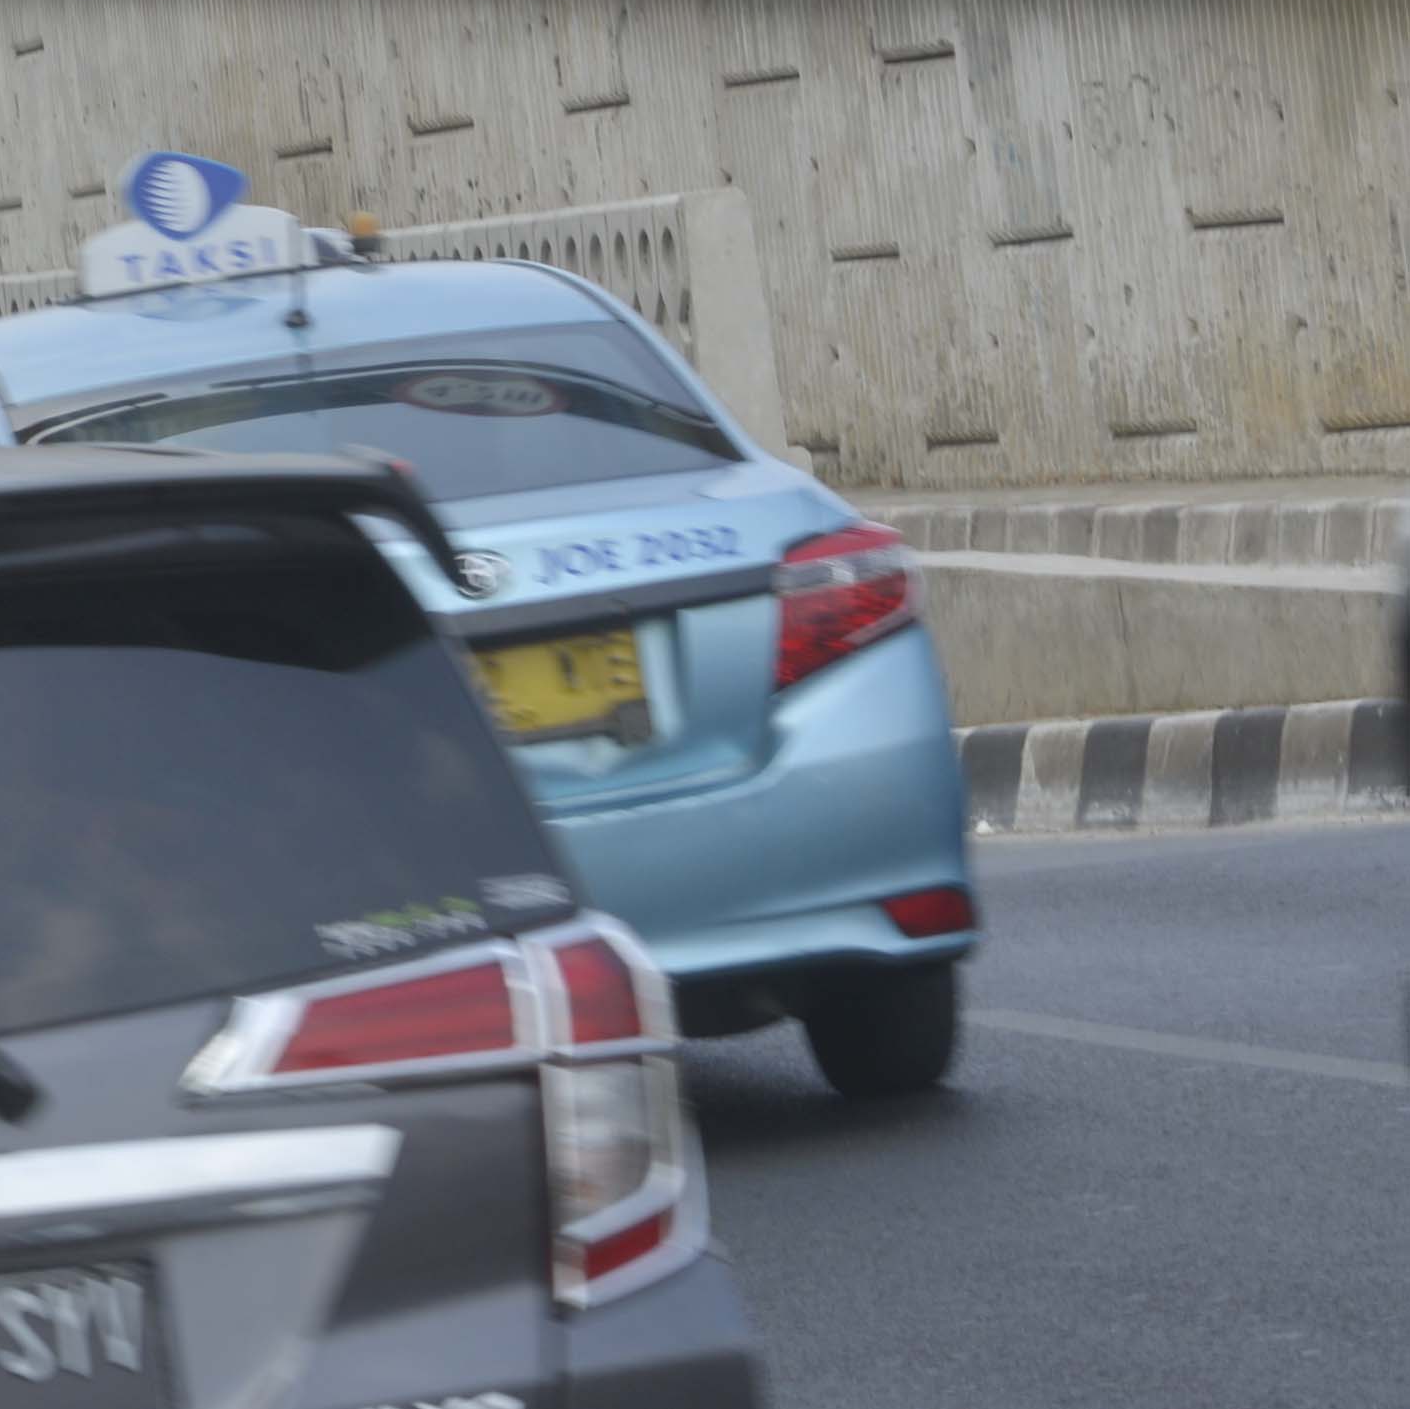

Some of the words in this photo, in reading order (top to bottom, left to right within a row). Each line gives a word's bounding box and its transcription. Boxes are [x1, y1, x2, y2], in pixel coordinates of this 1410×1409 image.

[116, 237, 278, 284] TAKSI
[533, 536, 624, 587] JOE
[635, 524, 743, 568] 2032
